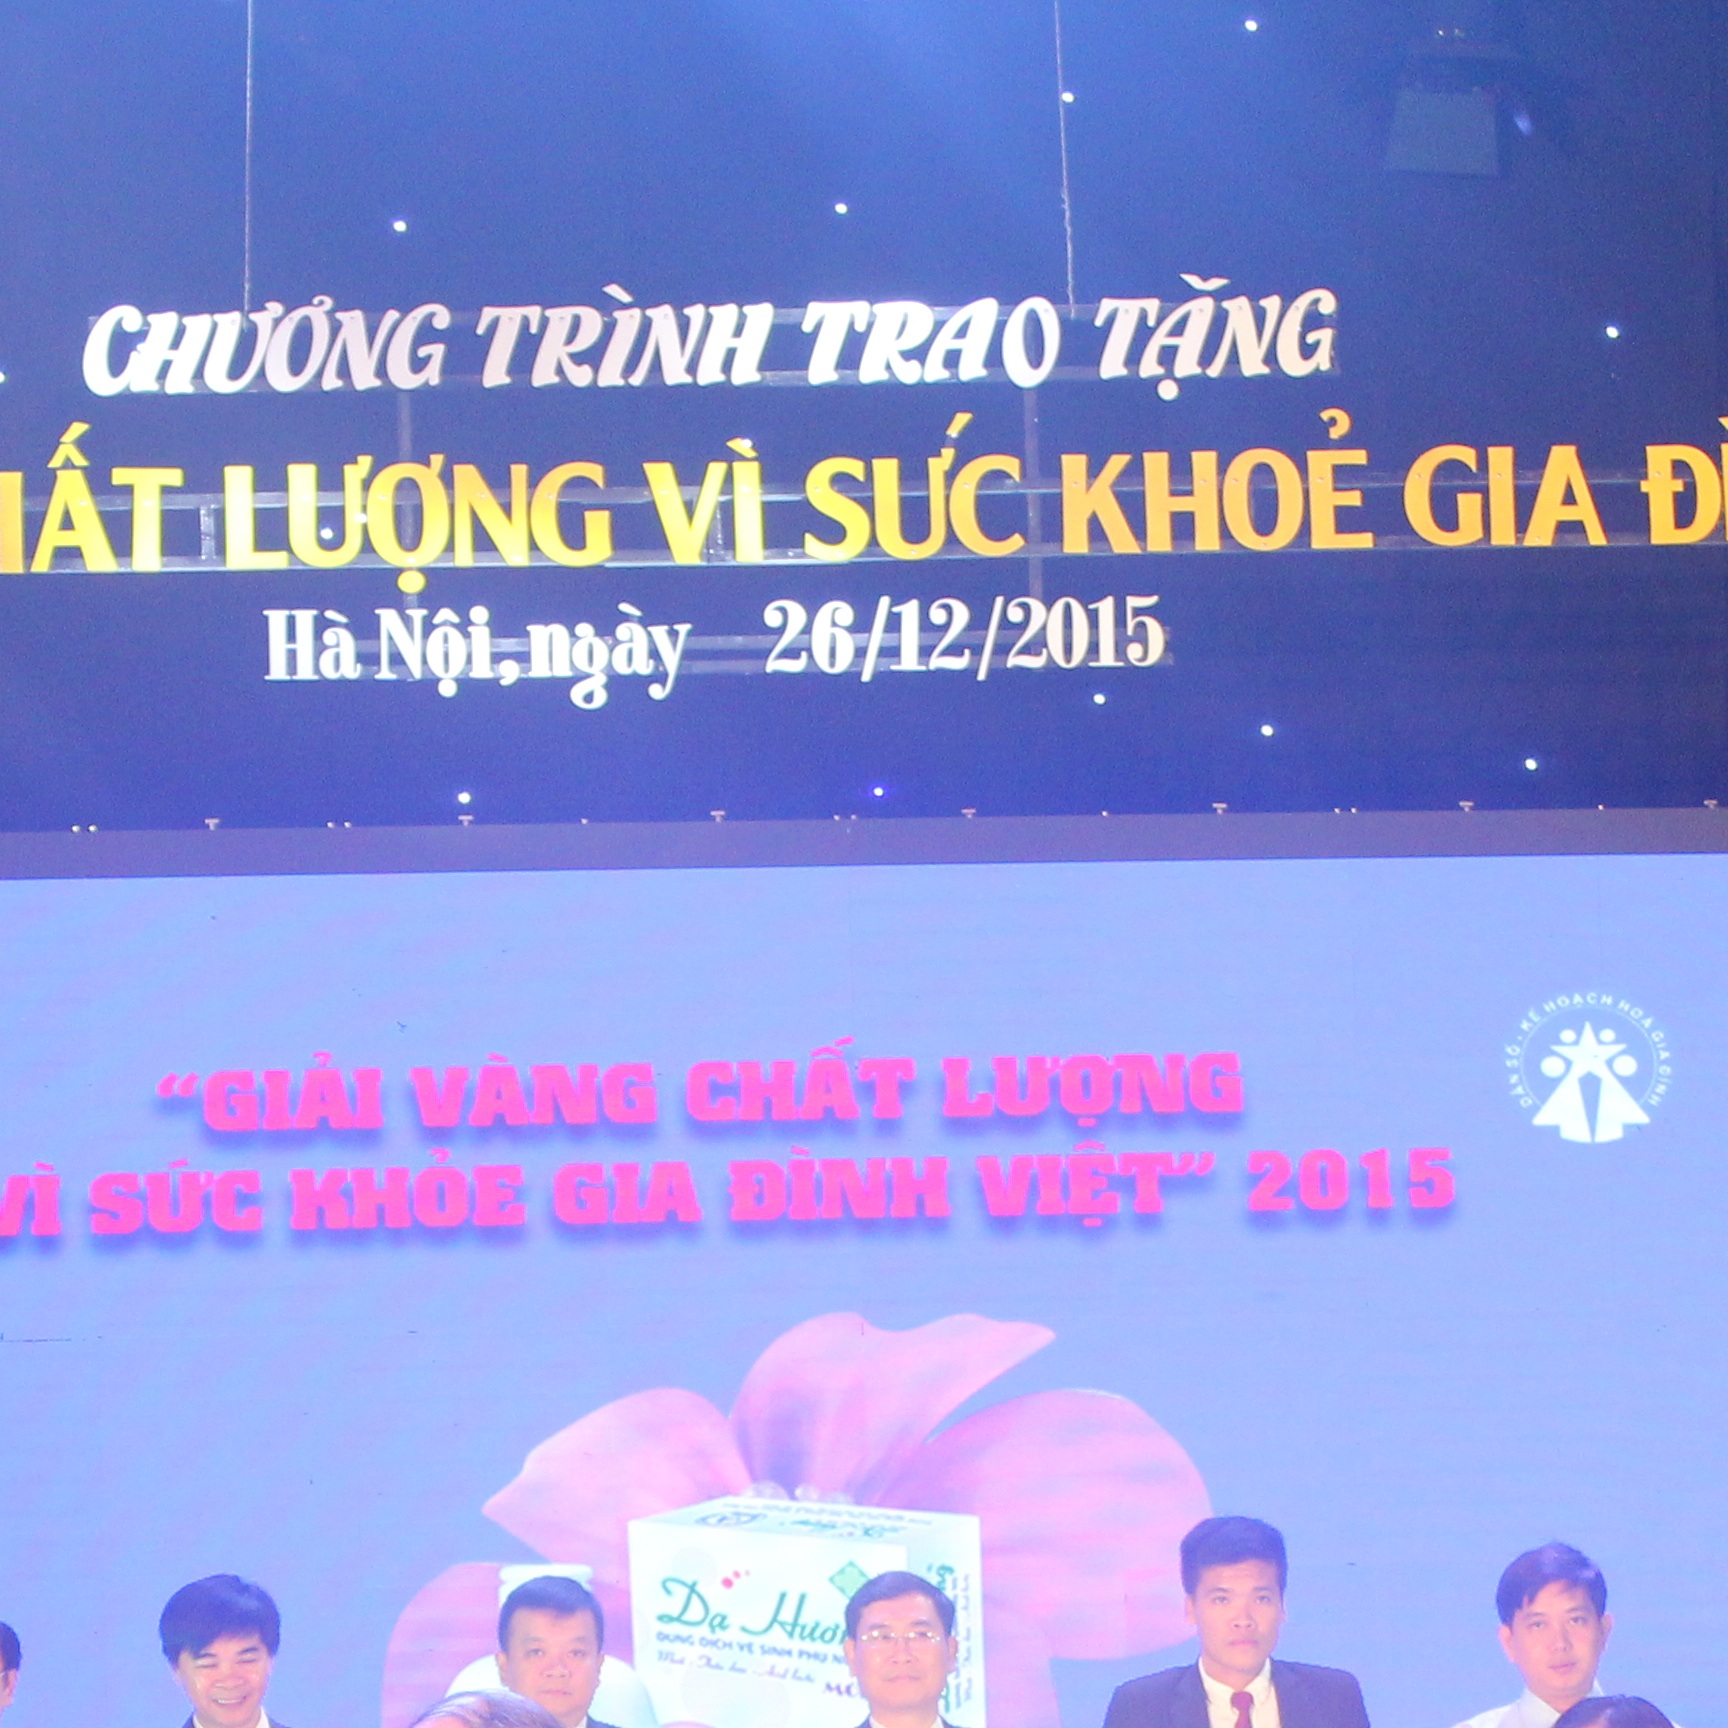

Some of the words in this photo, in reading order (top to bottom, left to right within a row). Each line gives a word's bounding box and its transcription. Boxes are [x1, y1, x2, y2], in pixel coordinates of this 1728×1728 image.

[83, 293, 450, 396] CHƯƠNG
[476, 284, 776, 389] TRÌNH
[801, 297, 1060, 388] TRAO
[1095, 273, 1337, 400] TẶNG
[224, 454, 614, 594] LƯỢNG
[643, 436, 766, 566] VÌ
[804, 411, 1026, 560] SỨC
[1060, 407, 1376, 554] KHOẺ
[1403, 443, 1610, 548] GIA
[262, 607, 363, 681] Hà
[763, 595, 1166, 684] 26/12/2015
[410, 1053, 657, 1128] VÀNG
[686, 1037, 915, 1122] CHẤT
[942, 1053, 1244, 1127] LƯỢNG
[90, 1159, 262, 1235] SỨC
[290, 1147, 526, 1231] KHỎE
[553, 1161, 702, 1225] GIA
[729, 1147, 951, 1221] ĐÌNH
[1248, 1148, 1456, 1212] 2015
[656, 1576, 731, 1635] Dạ
[740, 1591, 848, 1647] Hươ
